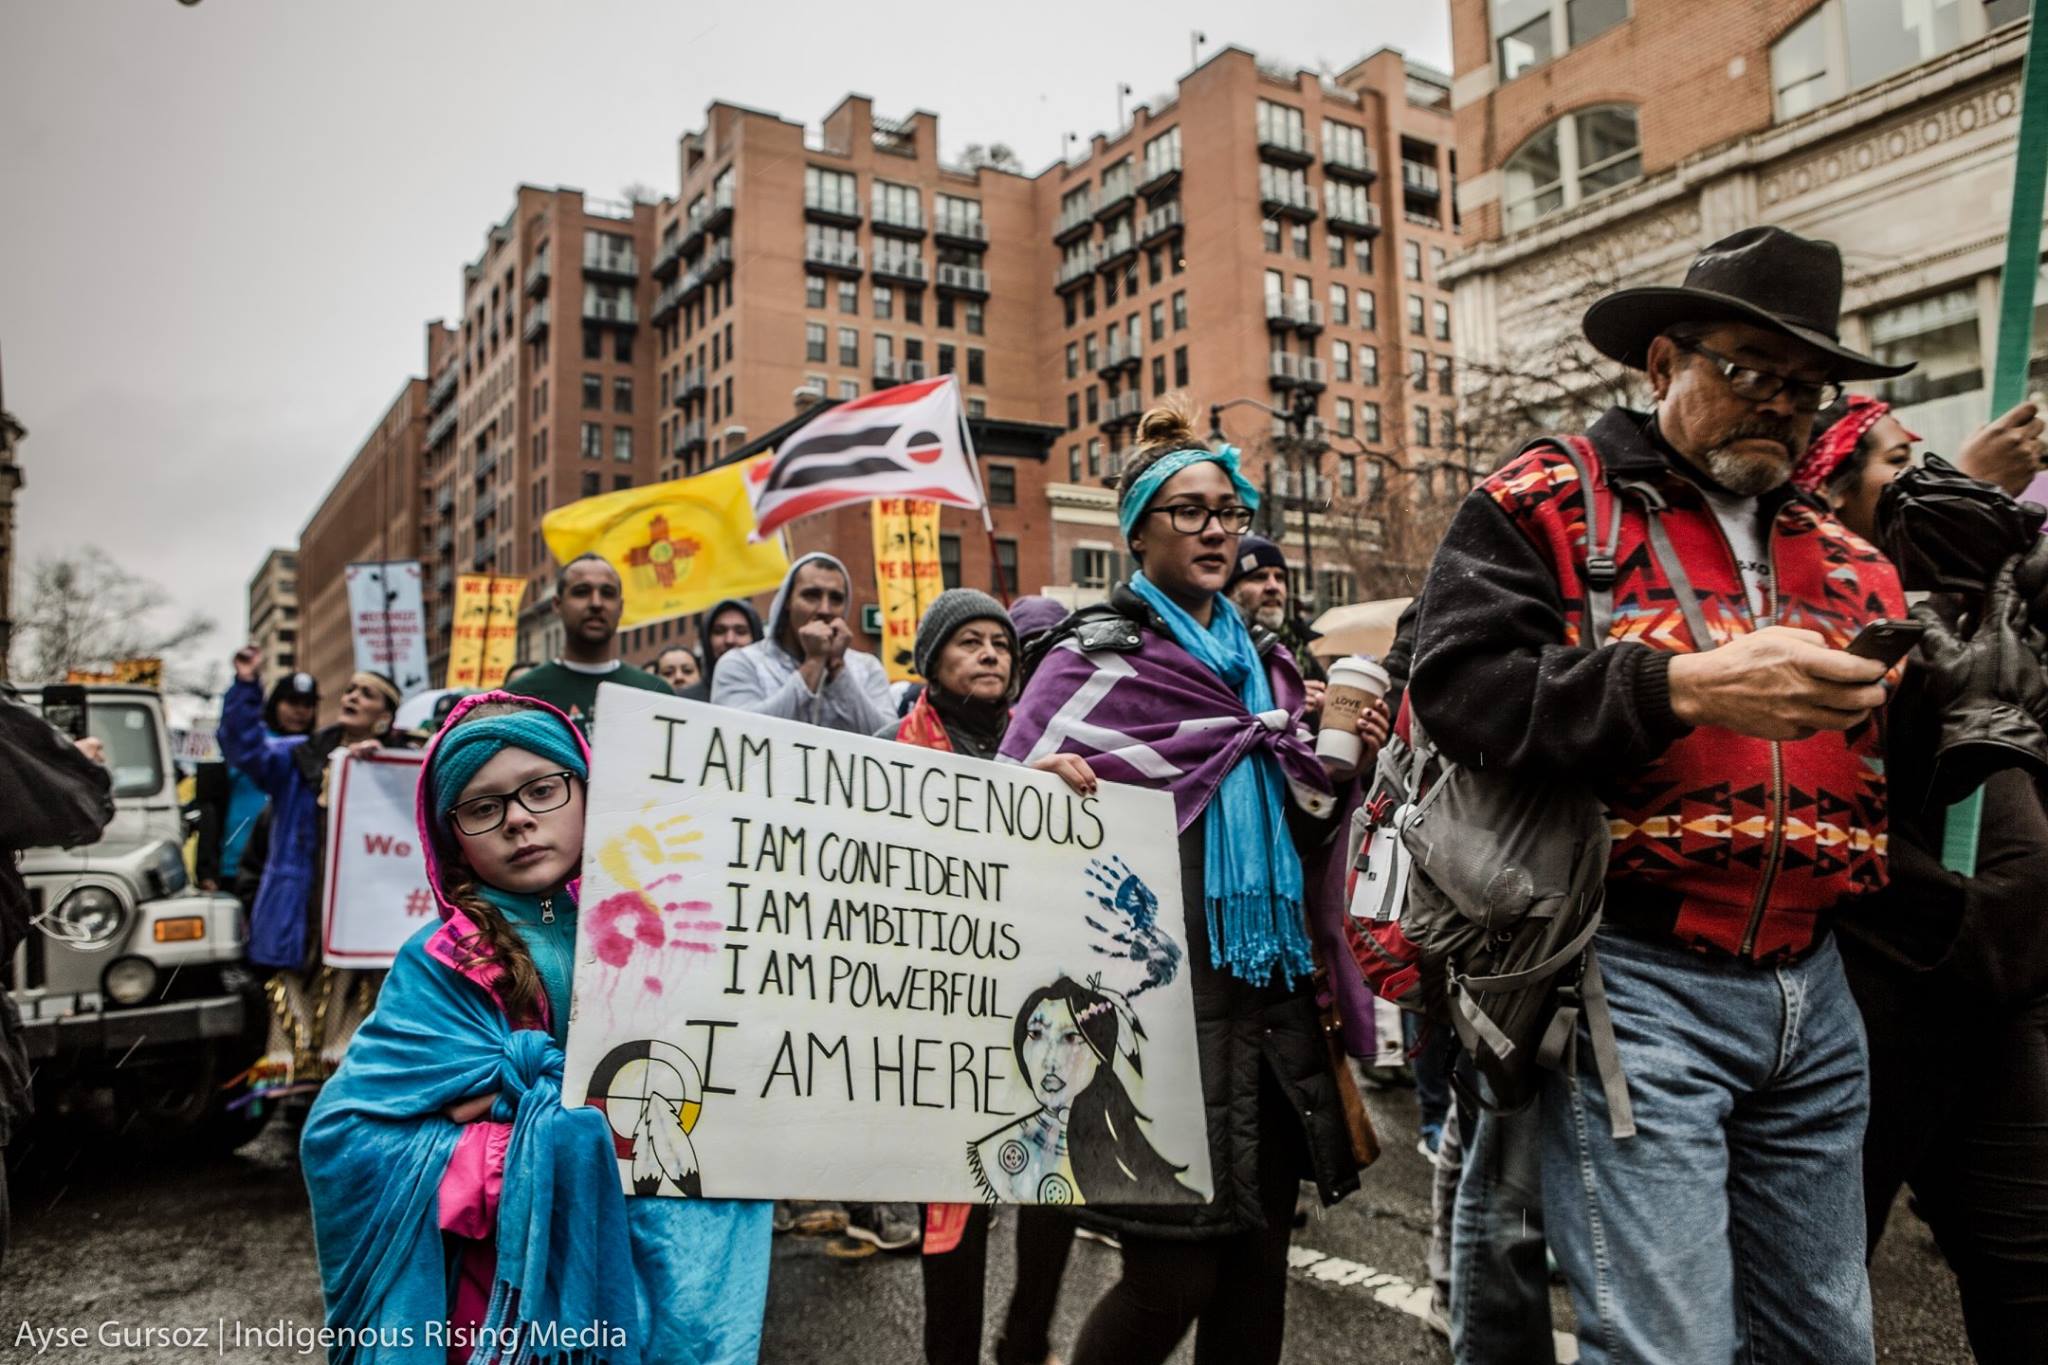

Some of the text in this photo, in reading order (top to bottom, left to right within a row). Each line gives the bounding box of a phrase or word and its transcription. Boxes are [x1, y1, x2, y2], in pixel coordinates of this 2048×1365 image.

[1335, 696, 1361, 709] LOVE
[649, 715, 687, 784] I
[699, 727, 773, 798] AM
[793, 743, 1105, 850] INDIGENOUS
[364, 833, 411, 857] We
[727, 817, 1010, 902] I AM CONFIDENT
[726, 882, 1021, 961] I AM AMBITIOUS
[723, 943, 1015, 1020] I AM POWERFUL
[685, 1018, 1017, 1117] I AM HERE
